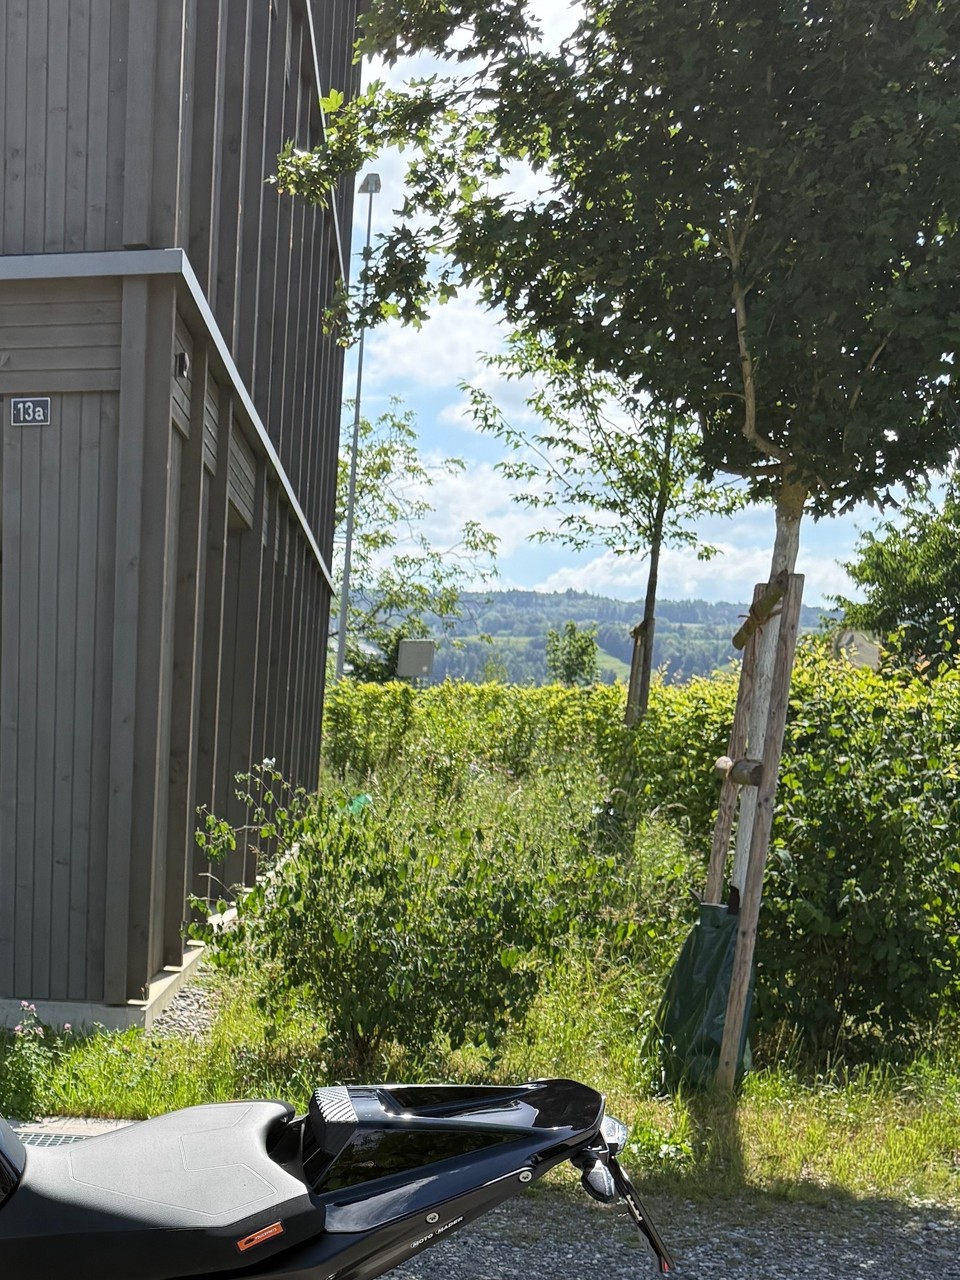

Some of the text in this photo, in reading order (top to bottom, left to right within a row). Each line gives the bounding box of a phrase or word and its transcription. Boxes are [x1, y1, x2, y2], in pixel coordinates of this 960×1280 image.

[17, 402, 44, 421] 13a
[410, 1215, 464, 1249] MOTO MADER
